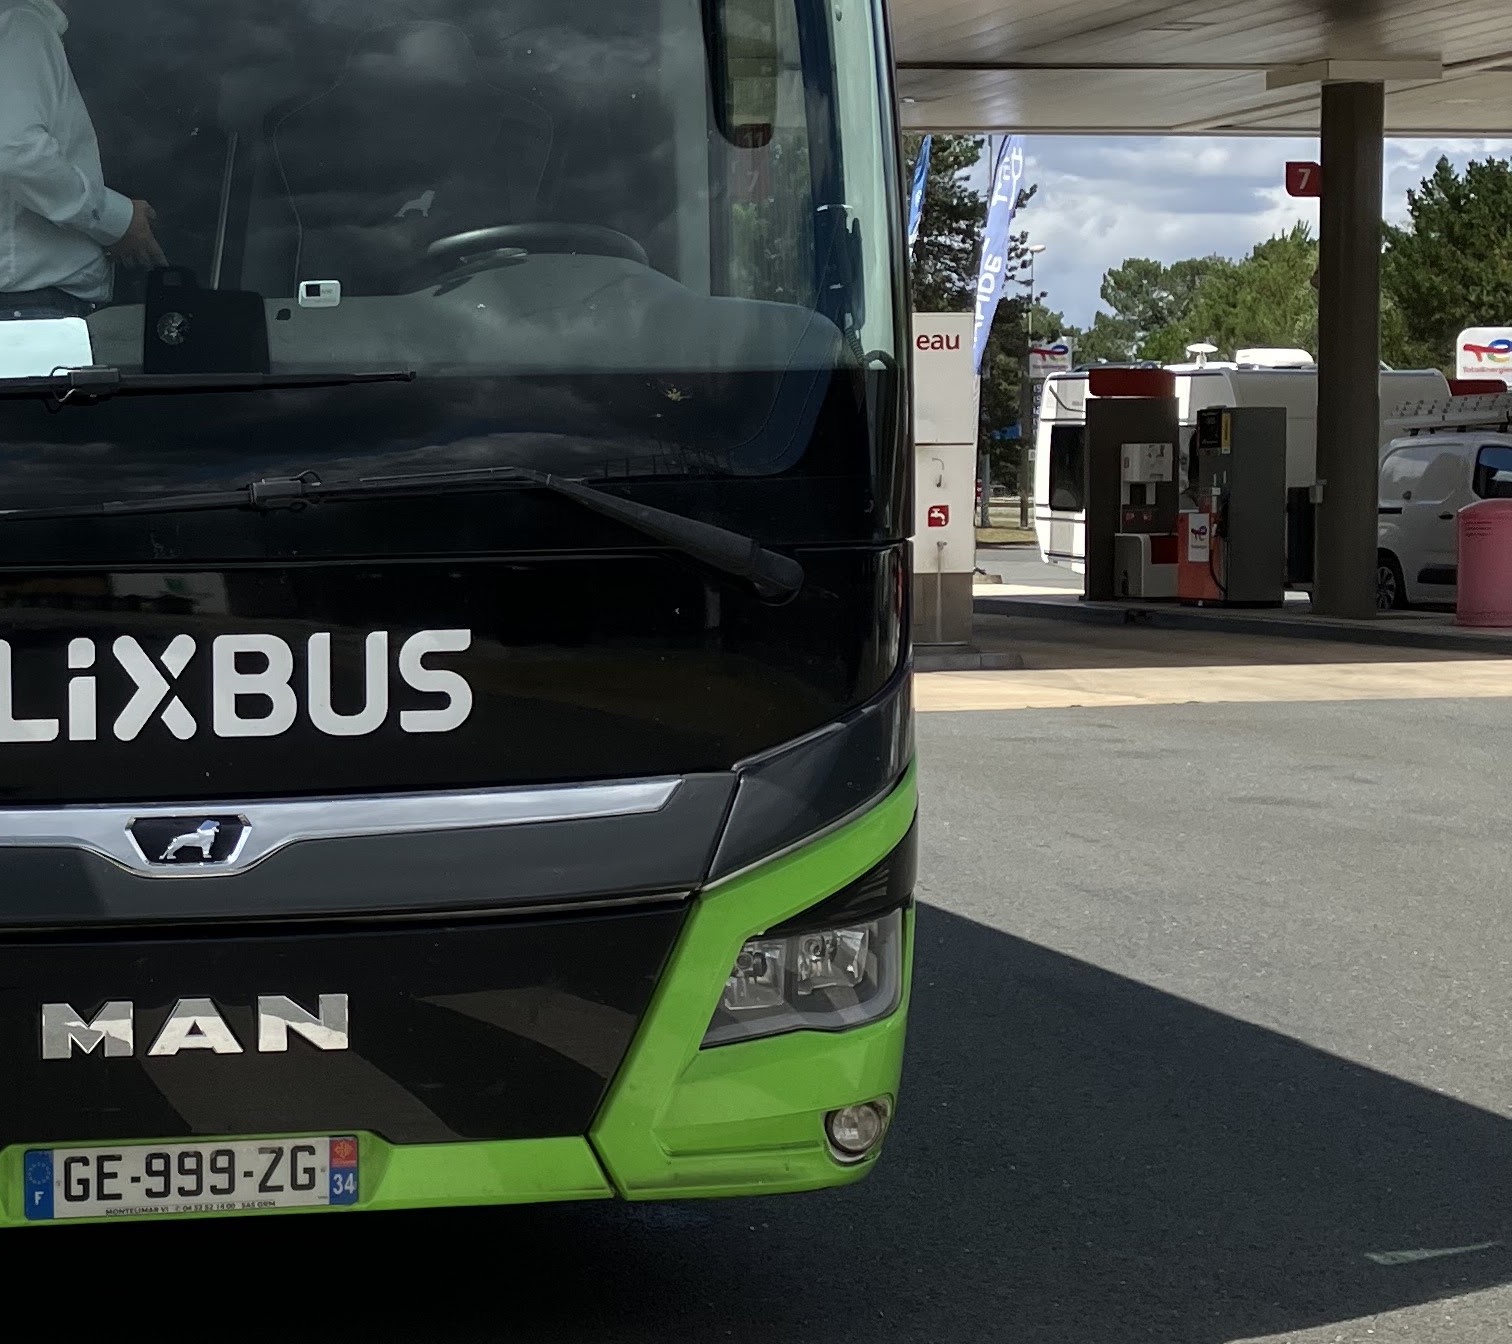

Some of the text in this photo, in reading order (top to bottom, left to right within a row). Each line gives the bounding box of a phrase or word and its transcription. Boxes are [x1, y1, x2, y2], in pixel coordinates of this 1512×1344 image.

[1298, 168, 1311, 190] 7
[916, 333, 960, 351] eau
[42, 993, 349, 1059] MAN
[64, 1145, 316, 1202] GE-999-ZG
[332, 1173, 356, 1195] 34
[34, 1191, 45, 1206] F
